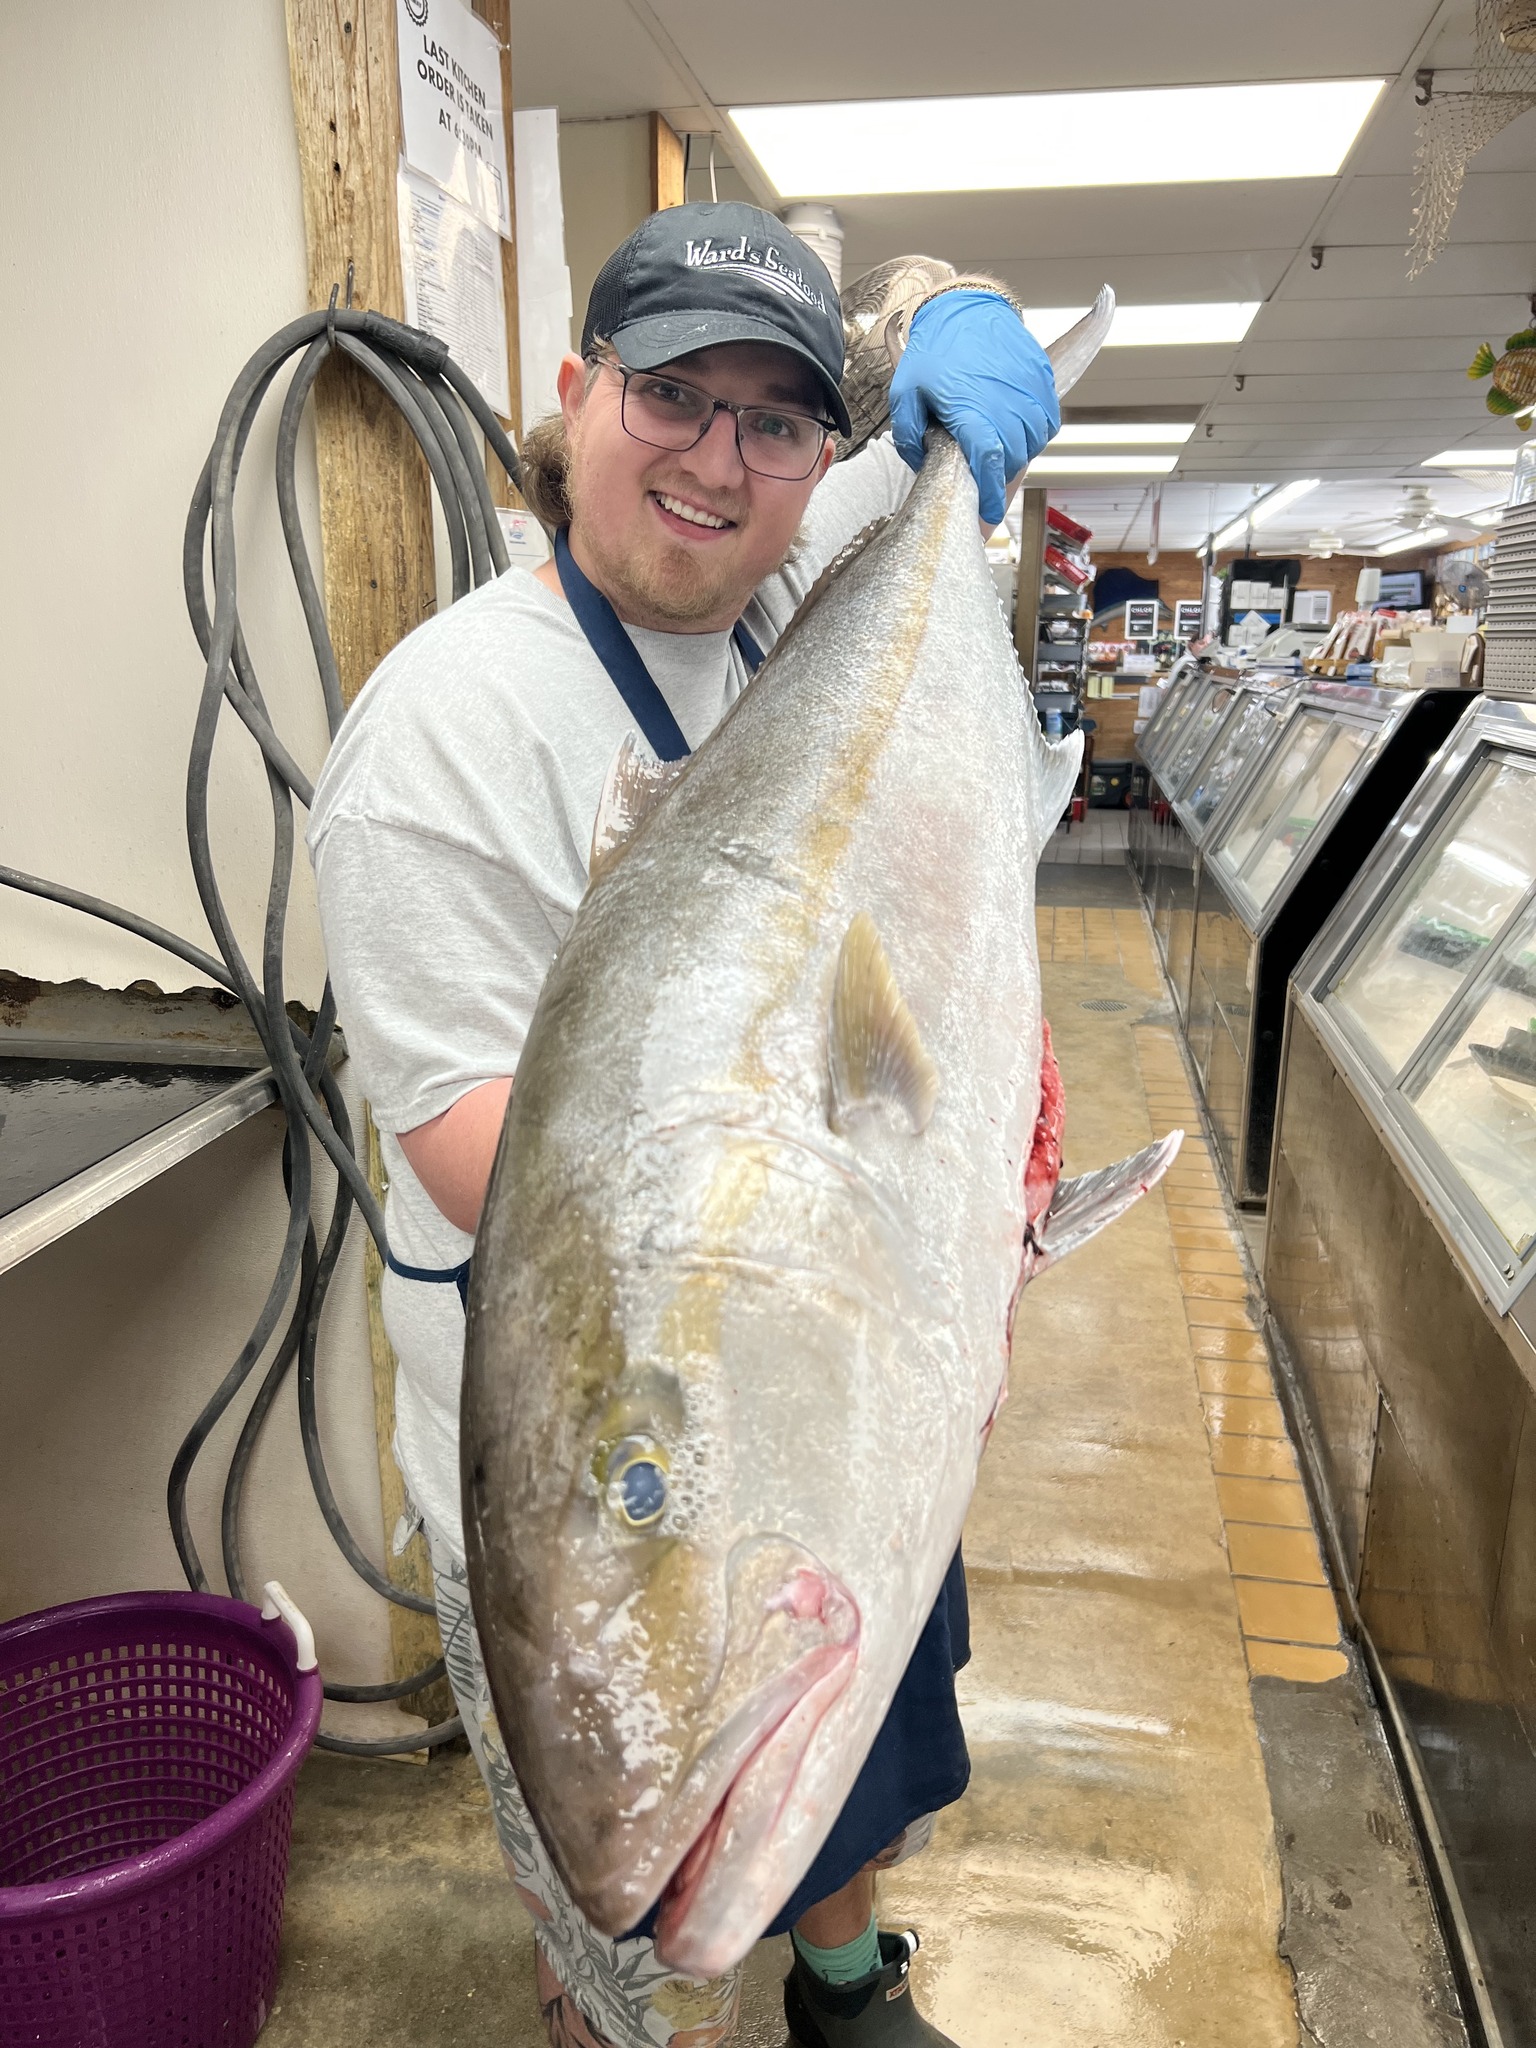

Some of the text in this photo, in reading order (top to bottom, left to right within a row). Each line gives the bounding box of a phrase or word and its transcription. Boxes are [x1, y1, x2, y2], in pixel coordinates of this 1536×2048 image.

[417, 59, 494, 141] ORDER IS TAKEN
[423, 34, 486, 110] LAST KITCHEN
[439, 108, 451, 132] AT
[685, 236, 828, 315] Ward's Seafood
